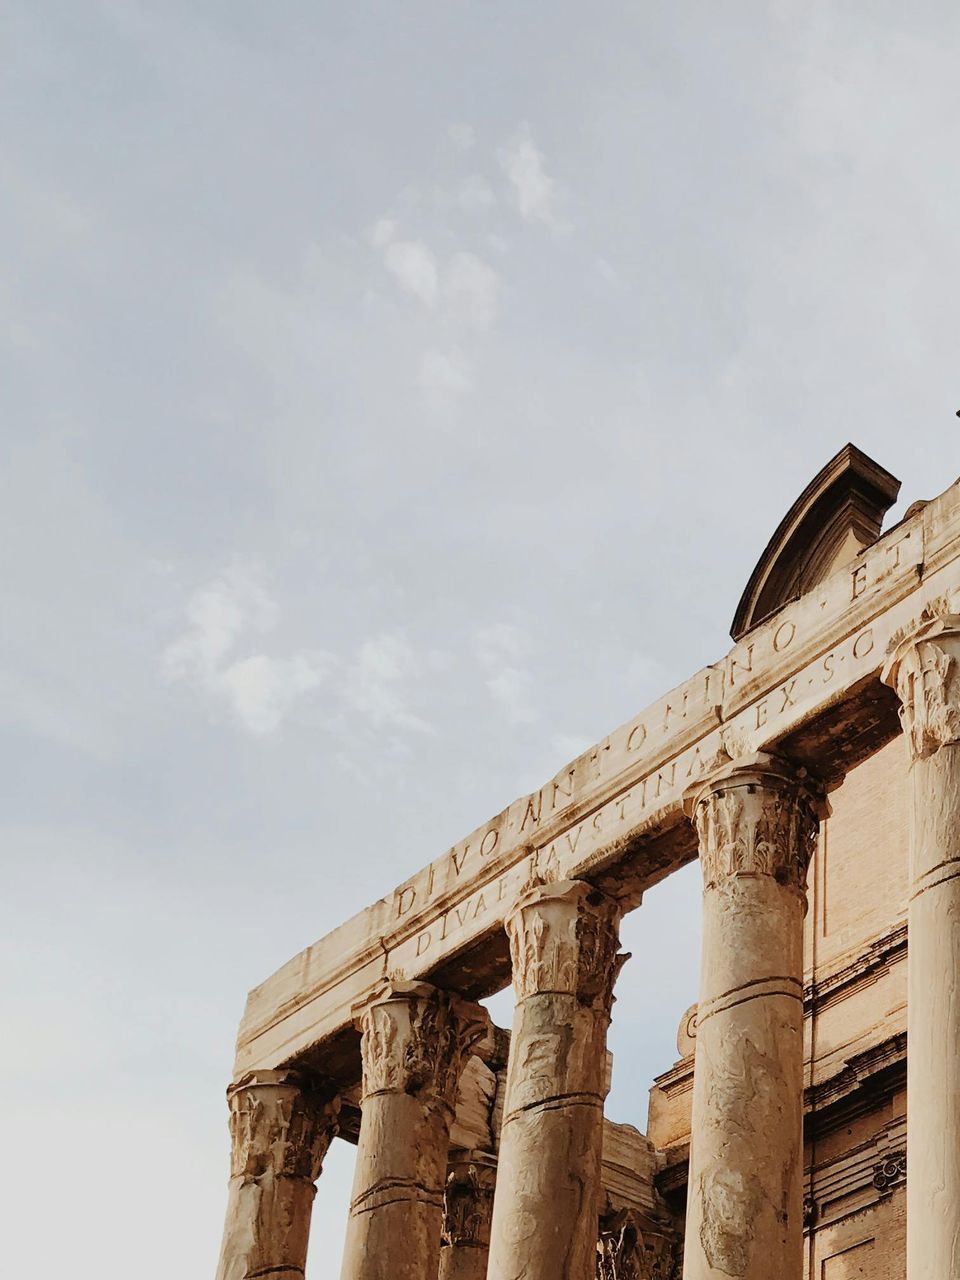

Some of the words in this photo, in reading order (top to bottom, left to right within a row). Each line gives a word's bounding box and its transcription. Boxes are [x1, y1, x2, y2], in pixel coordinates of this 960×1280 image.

[396, 828, 499, 919] DIVO
[850, 532, 911, 600] ET
[754, 680, 797, 730] EX
